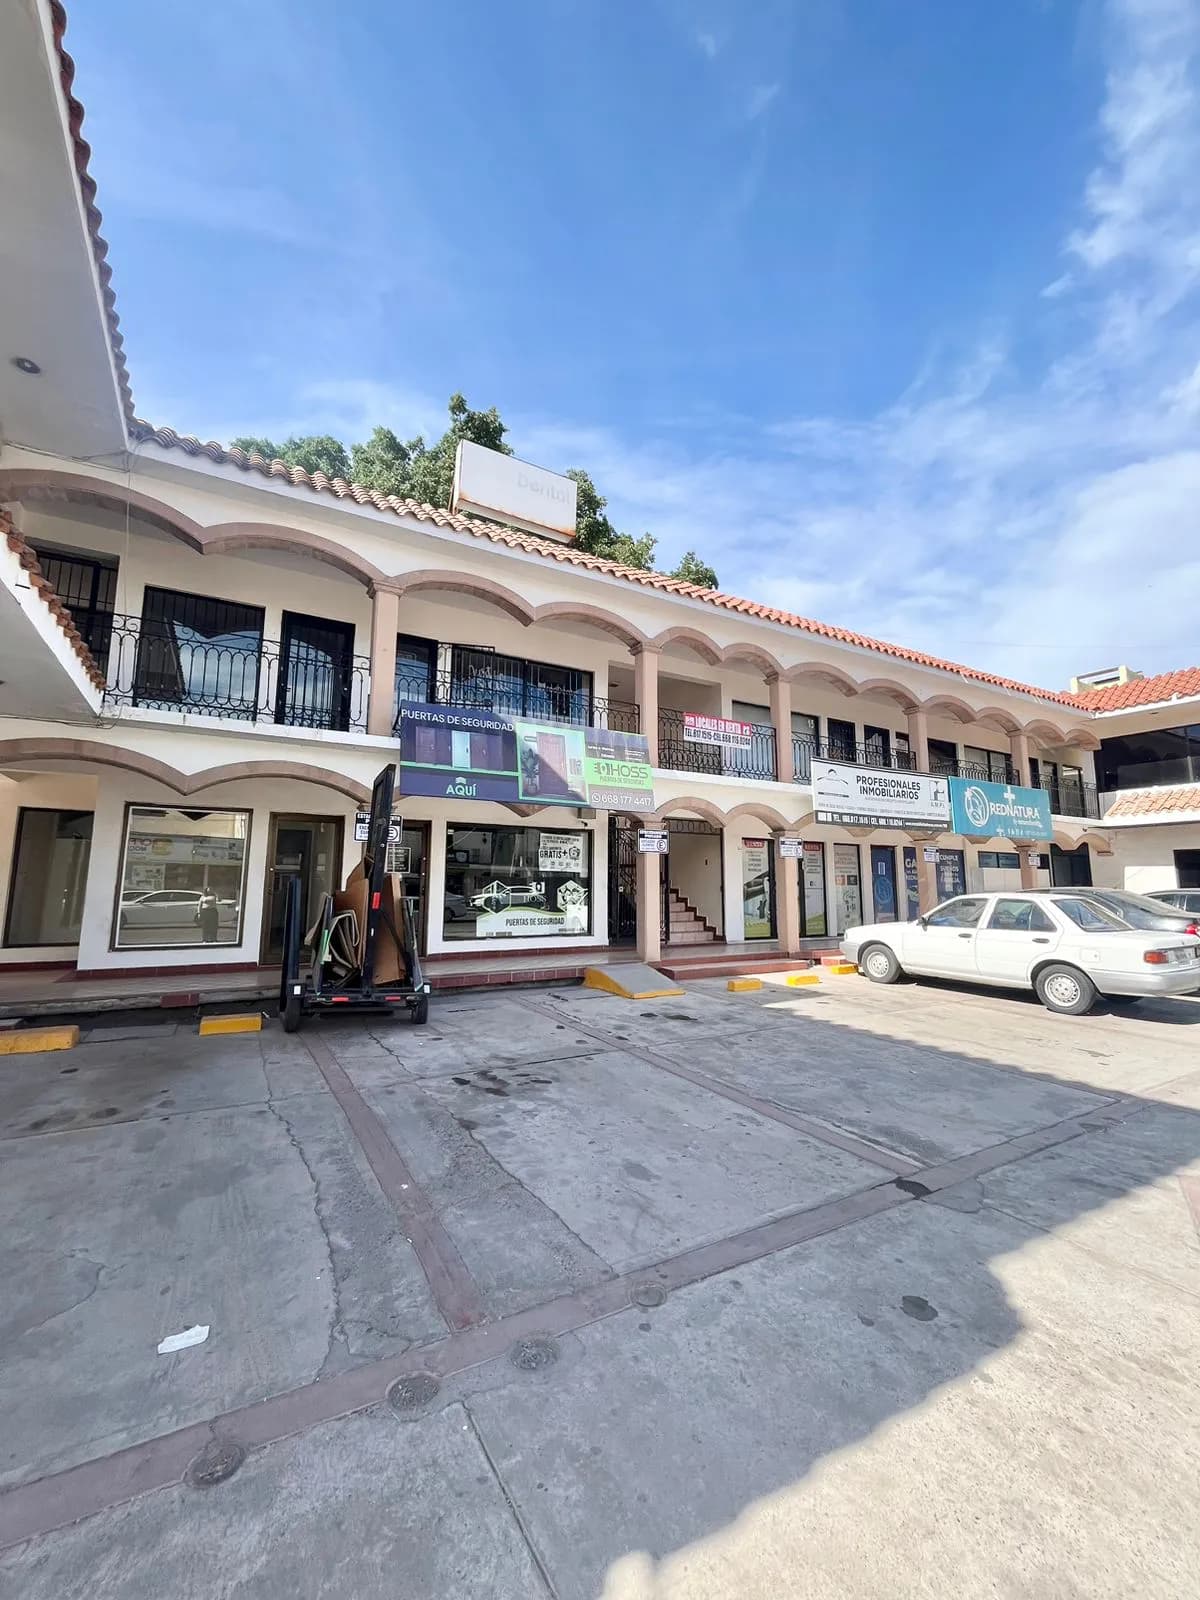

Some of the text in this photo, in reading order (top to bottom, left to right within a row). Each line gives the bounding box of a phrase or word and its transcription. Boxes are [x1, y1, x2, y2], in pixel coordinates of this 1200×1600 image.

[401, 709, 514, 732] PUERTAS DE SEGURIDAD
[611, 763, 648, 779] HOSS
[446, 783, 477, 797] AQUÍ
[856, 775, 921, 791] PROFESIONALES
[602, 794, 651, 806] 668 177 4417
[859, 787, 919, 800] INMOBILIARIOS
[989, 802, 1041, 819] REDNATURA
[539, 850, 562, 859] GRATIS
[505, 917, 565, 927] PUERTAS DE SEGURIDAD
